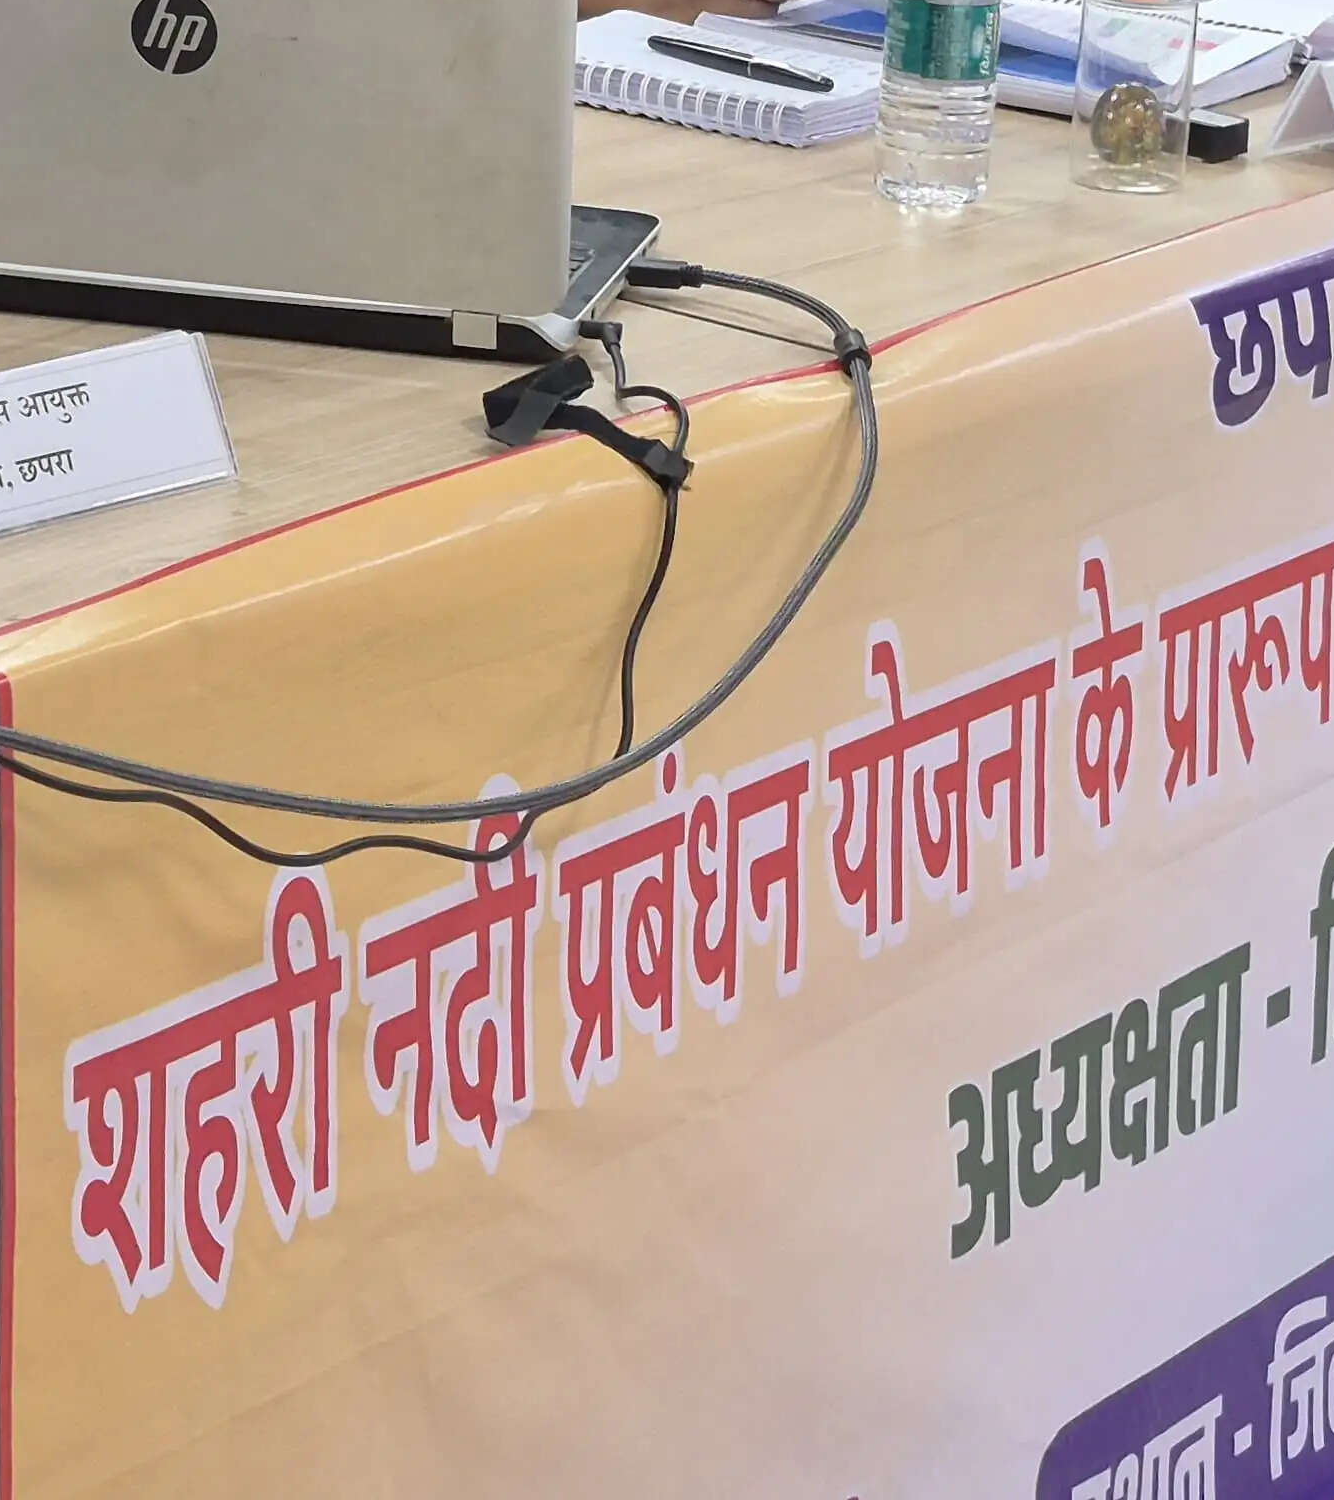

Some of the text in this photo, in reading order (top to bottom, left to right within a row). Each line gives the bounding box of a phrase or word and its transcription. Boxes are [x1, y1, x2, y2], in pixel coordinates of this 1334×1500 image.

[15, 448, 74, 484] छपरा
[17, 382, 91, 424] आयुक्त
[74, 876, 342, 1284] शहरी
[366, 812, 537, 1149] नदी
[559, 753, 809, 1080] प्रबंधन
[828, 641, 1056, 936] योजना
[1072, 558, 1143, 827] के
[949, 942, 1252, 1260] अध्यक्षता
